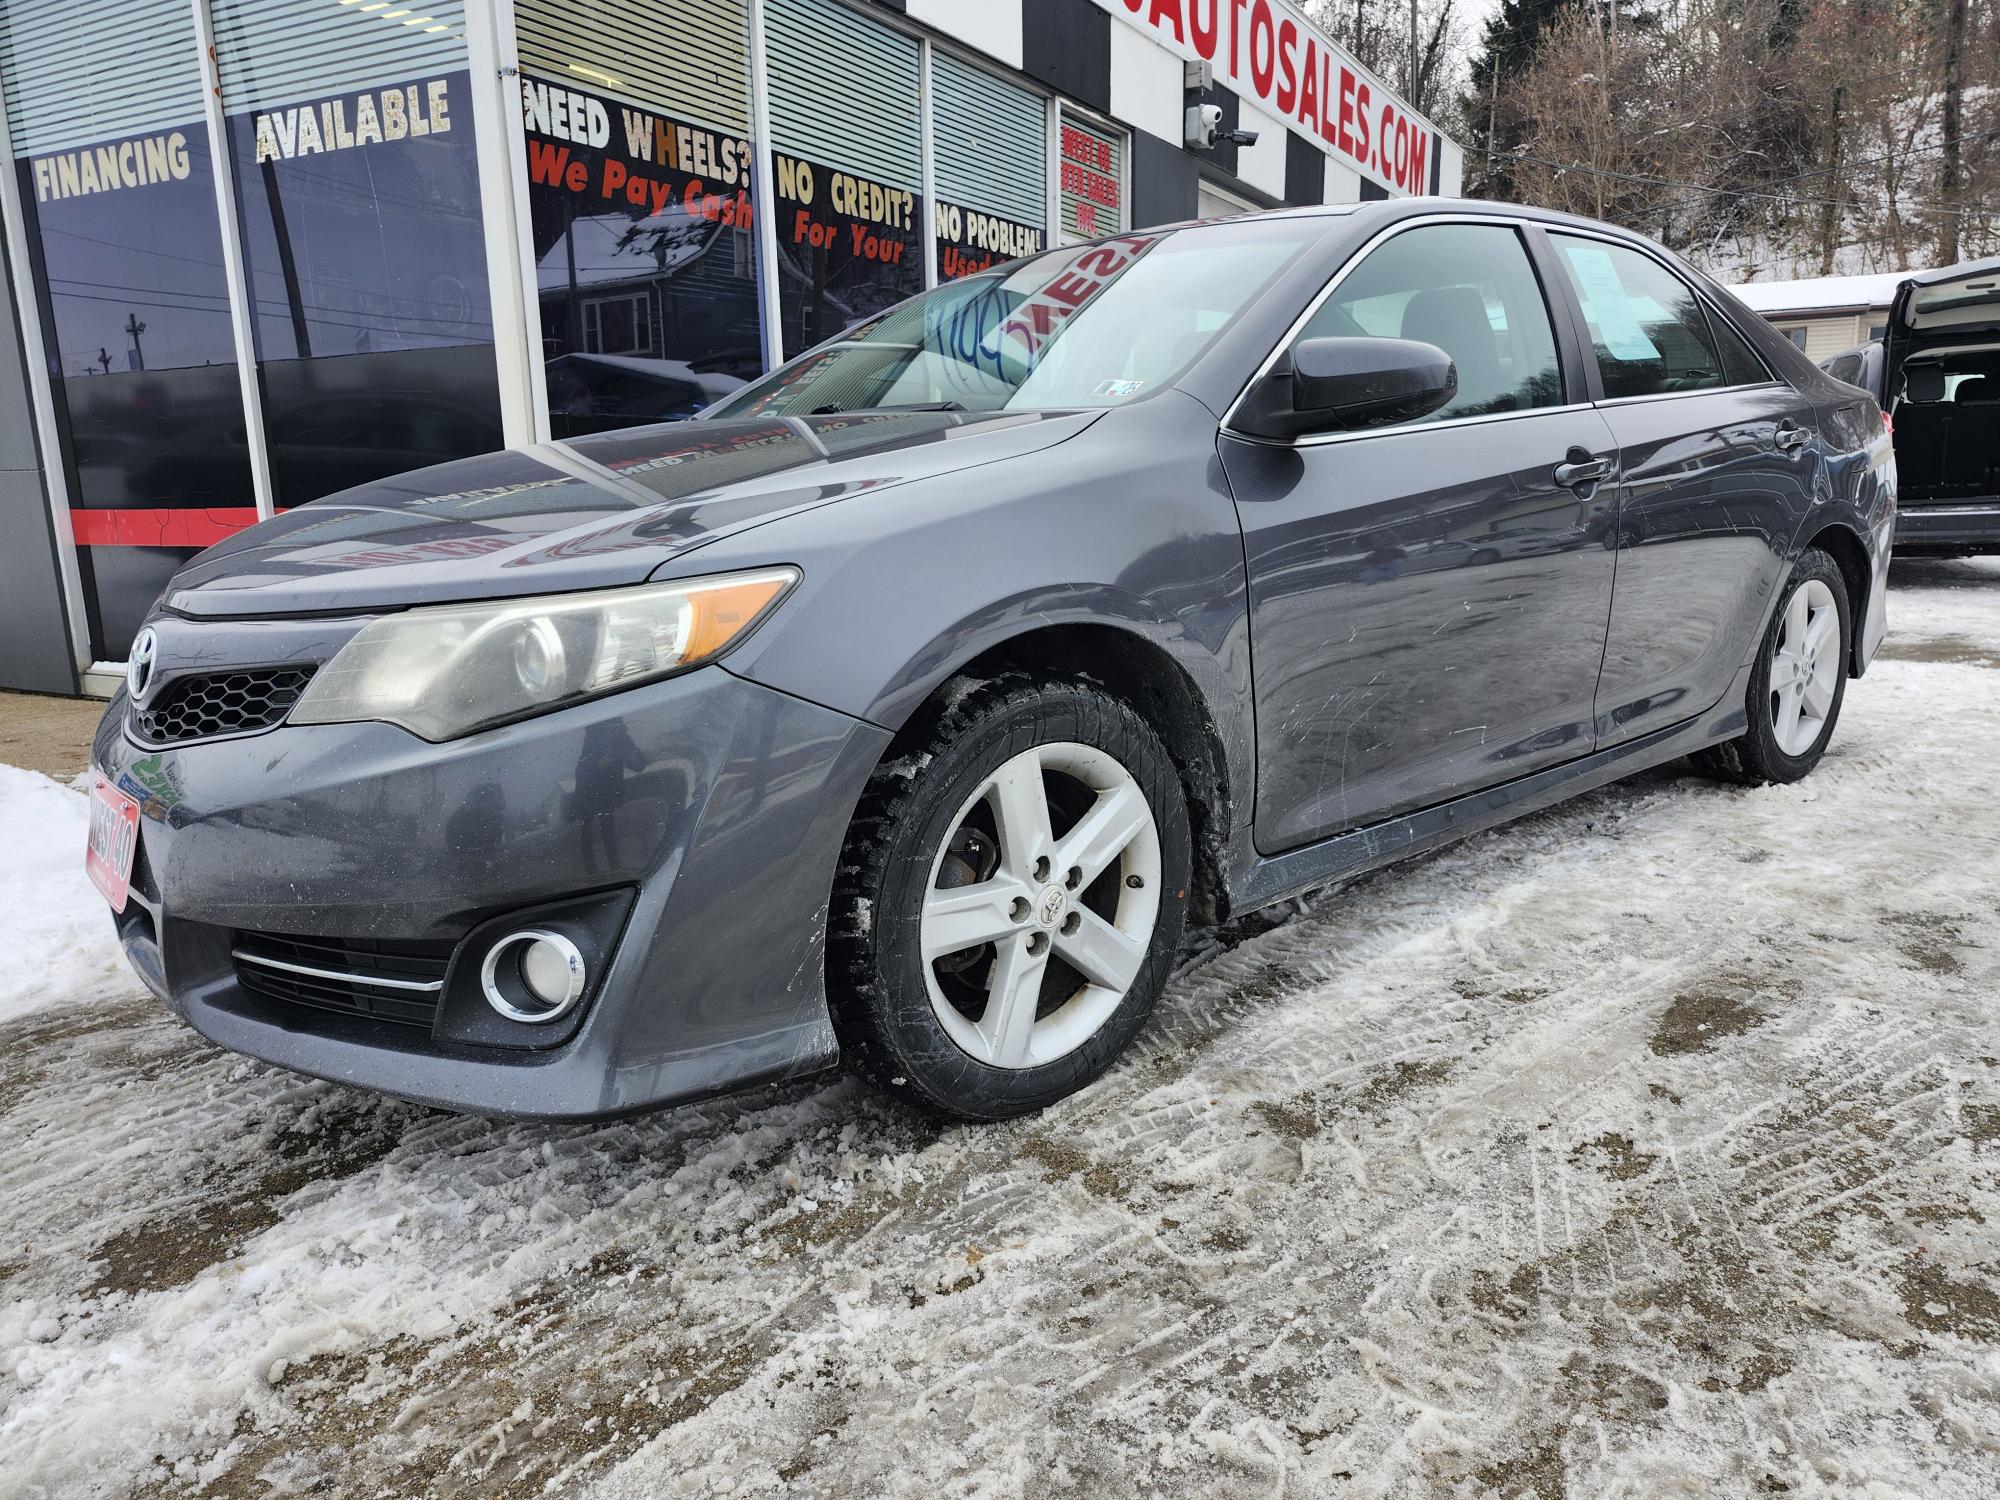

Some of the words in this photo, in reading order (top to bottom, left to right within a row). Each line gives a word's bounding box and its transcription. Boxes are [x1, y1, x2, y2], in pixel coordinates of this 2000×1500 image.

[256, 80, 451, 163] AVAILABLE
[522, 78, 610, 148] NEED
[622, 108, 752, 188] WHEELS?
[1062, 125, 1094, 165] WEST
[34, 132, 190, 202] FINANCING
[529, 140, 588, 192] We
[602, 158, 671, 216] Pay
[684, 179, 752, 229] Cash
[777, 155, 814, 205] NO
[831, 172, 913, 231] CREDIT?
[794, 209, 837, 249] For
[850, 223, 904, 263] Your
[936, 203, 961, 243] NO
[967, 212, 1041, 258] PROBLEM!
[944, 246, 991, 278] Used
